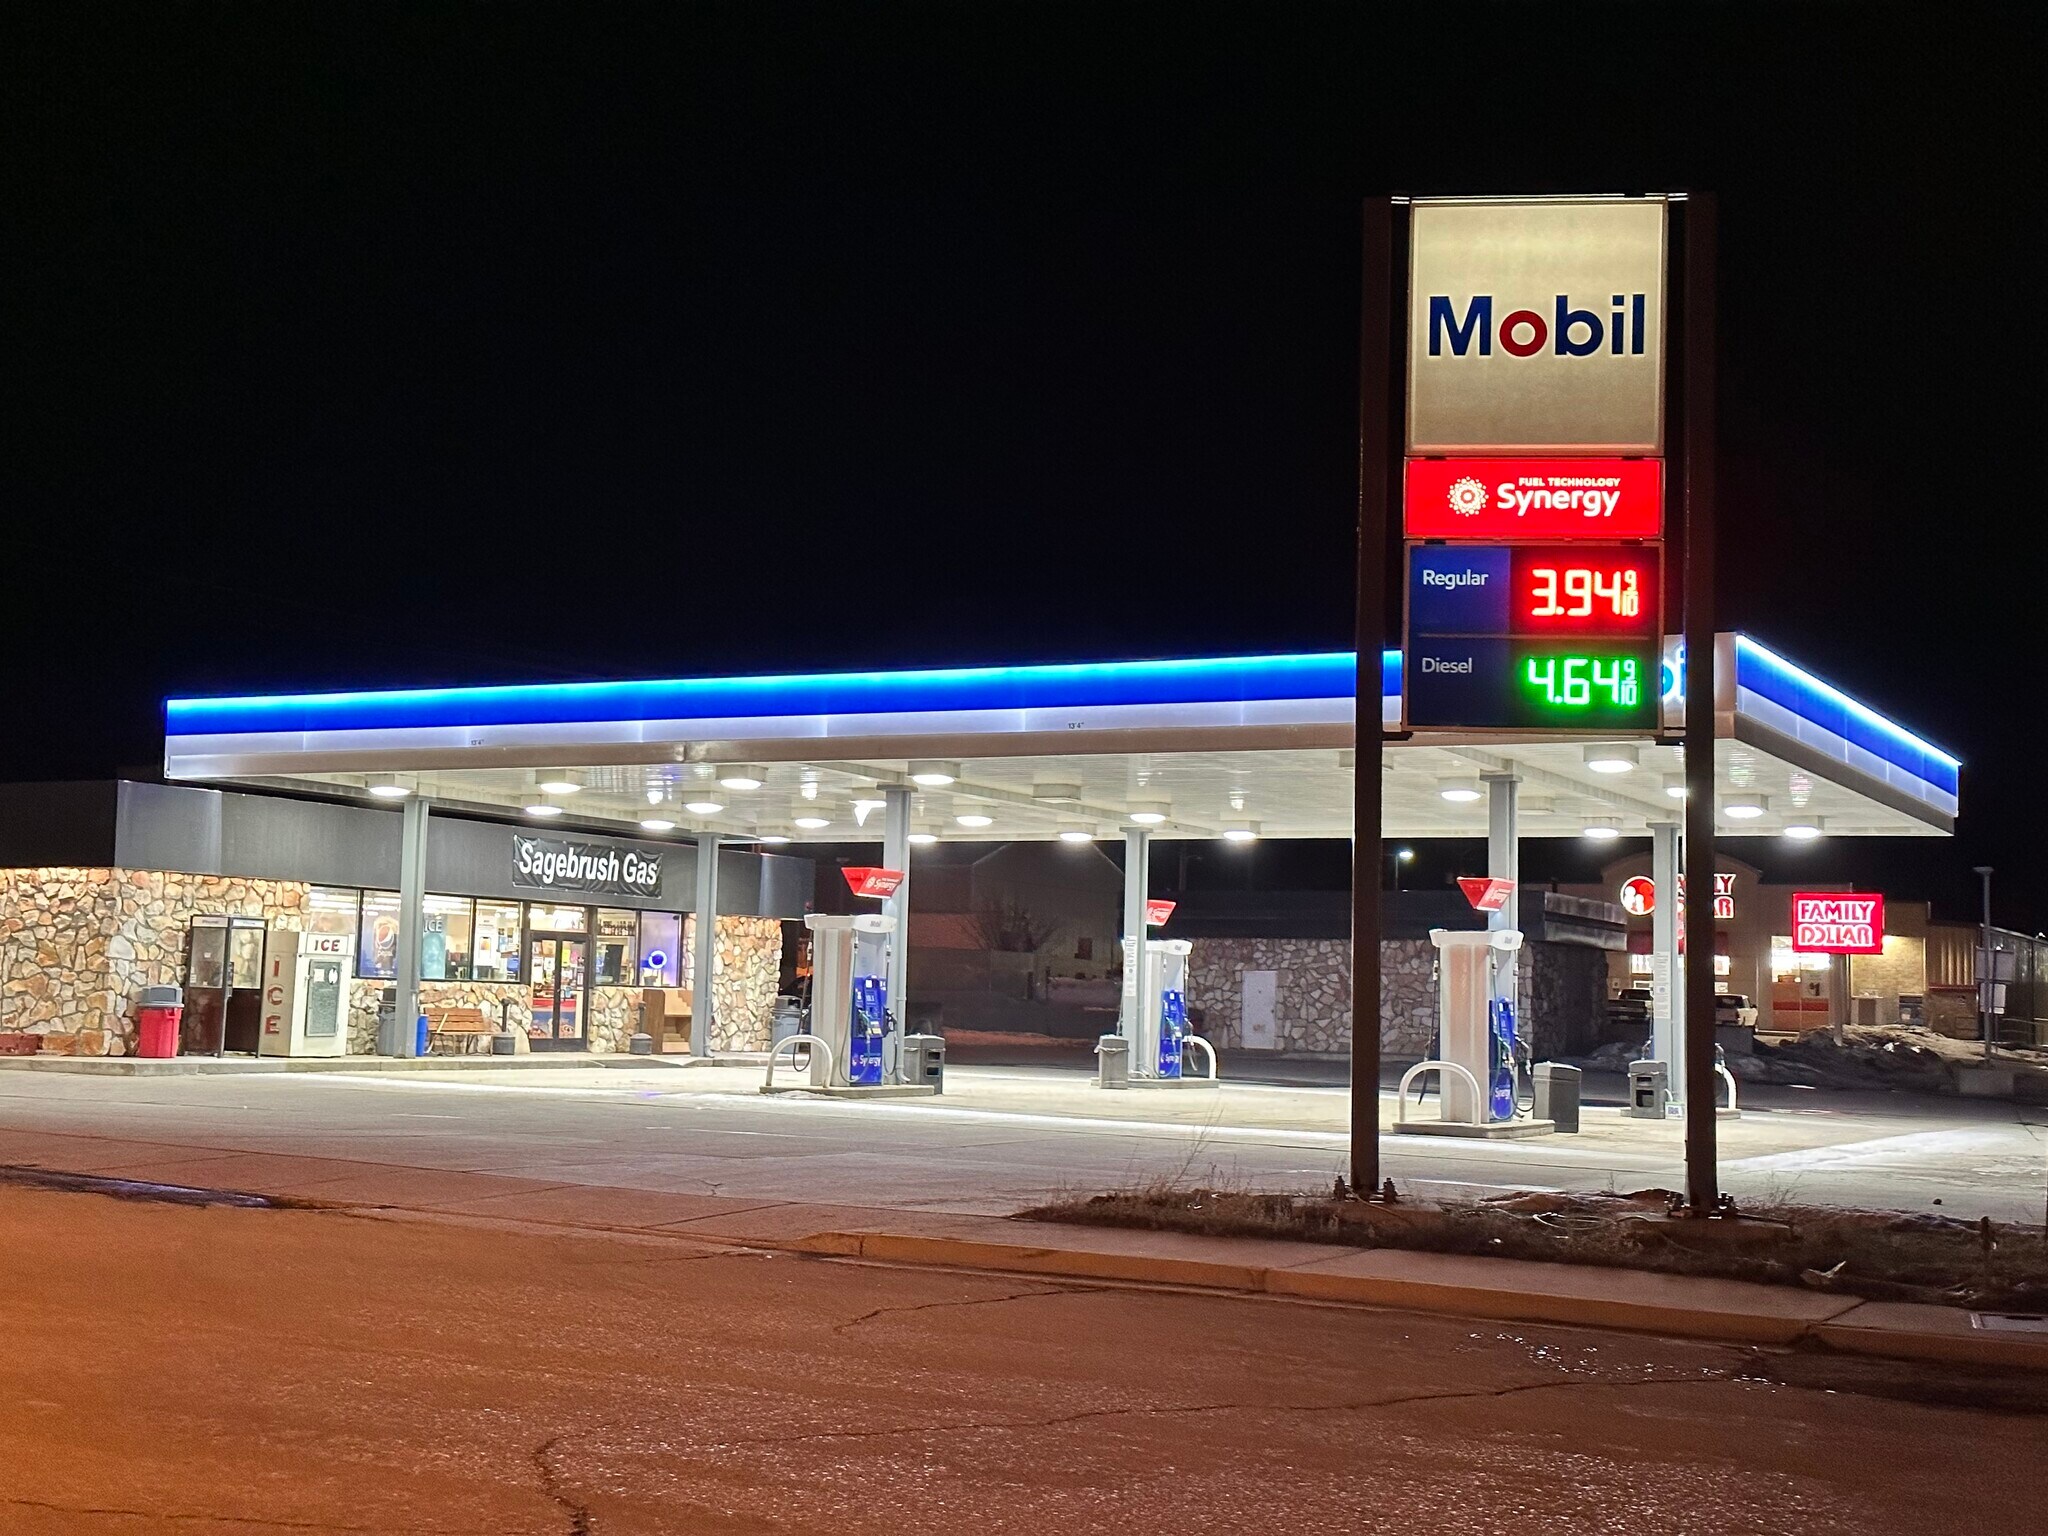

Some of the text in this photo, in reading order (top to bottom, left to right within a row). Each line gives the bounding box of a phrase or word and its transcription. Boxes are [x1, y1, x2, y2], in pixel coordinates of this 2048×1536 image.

[1429, 294, 1645, 357] Mobil
[1518, 477, 1621, 487] FUEL TECHNOLOGY
[1497, 483, 1621, 517] Synergy
[1422, 569, 1489, 590] Regular
[1422, 657, 1473, 674] Diesel
[519, 842, 658, 886] Sagebrush Gas
[1799, 900, 1874, 922] FAMILY
[314, 939, 341, 952] ICE
[1799, 924, 1874, 946] DOLLAR
[264, 954, 285, 1036] ICE
